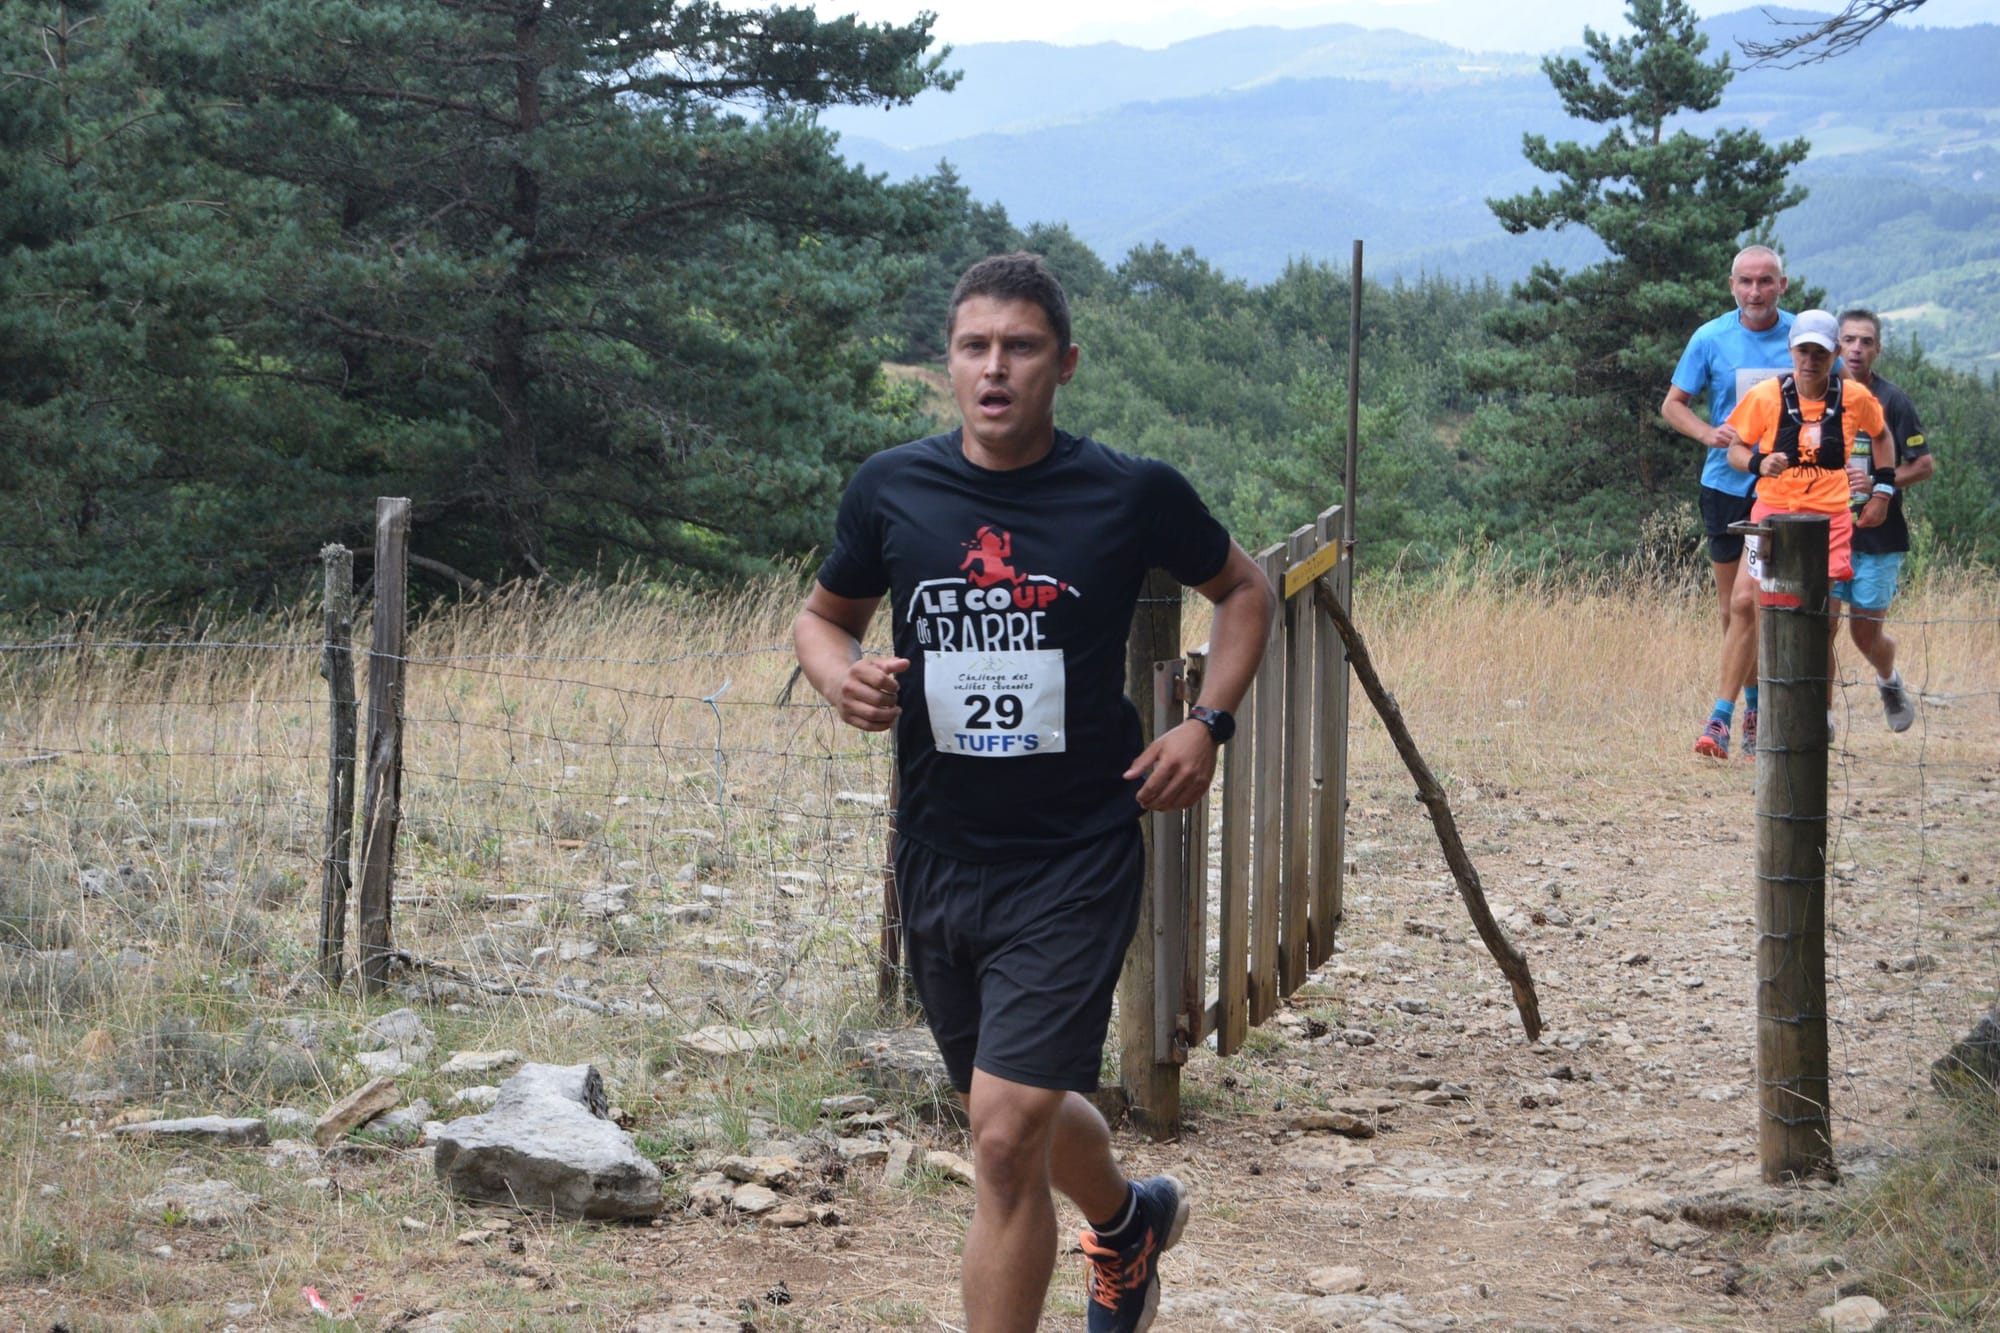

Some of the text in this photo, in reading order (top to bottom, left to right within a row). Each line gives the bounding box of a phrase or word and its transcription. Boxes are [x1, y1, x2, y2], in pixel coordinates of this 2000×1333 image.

[921, 585, 1058, 614] LE COUP
[916, 611, 1047, 652] de BARRE
[959, 673, 1028, 685] Challenge des
[964, 694, 1024, 730] 29
[954, 733, 1039, 752] TUFF'S
